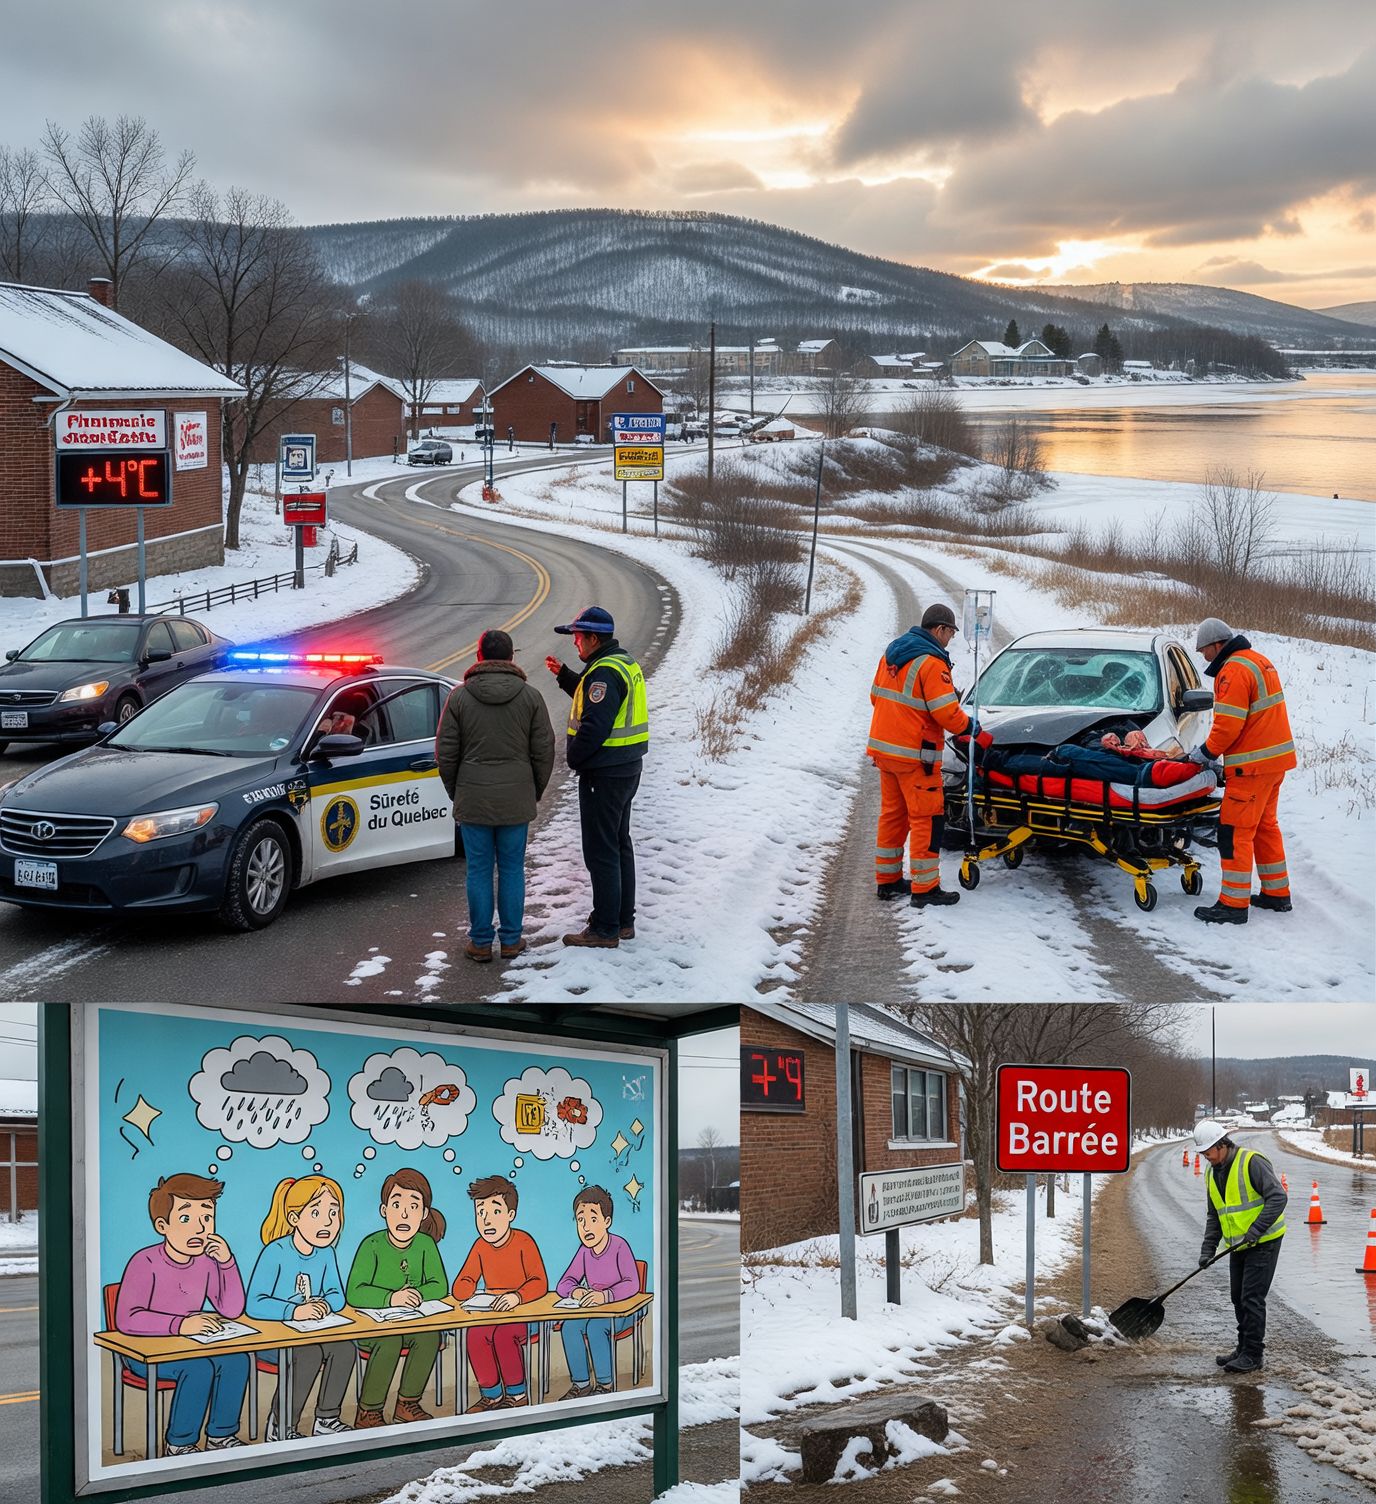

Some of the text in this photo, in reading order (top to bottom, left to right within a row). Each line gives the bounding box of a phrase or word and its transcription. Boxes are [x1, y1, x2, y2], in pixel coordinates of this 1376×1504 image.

[80, 459, 159, 498] +4°C
[367, 814, 388, 830] du
[1016, 1080, 1112, 1114] Route
[1008, 1122, 1119, 1156] Barrée
